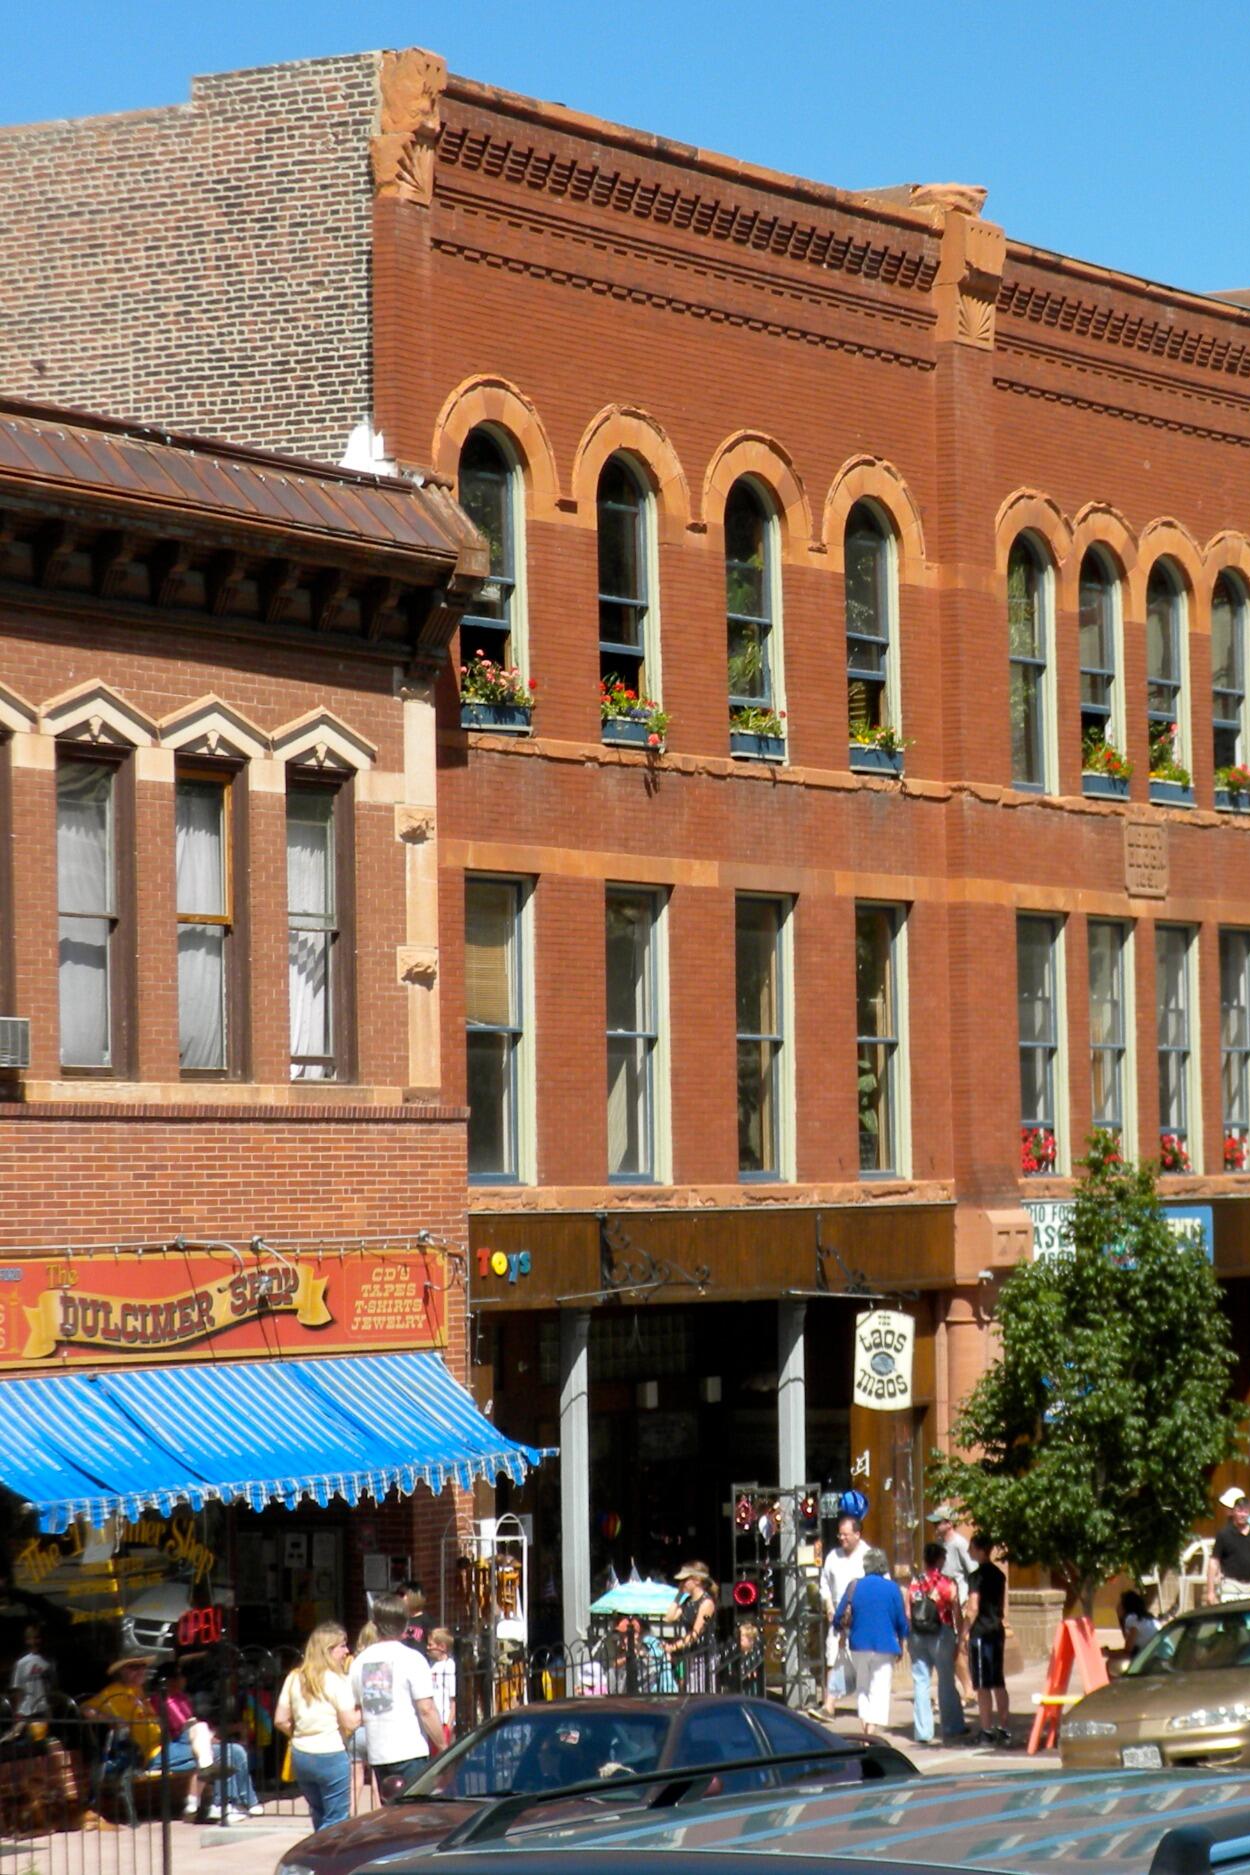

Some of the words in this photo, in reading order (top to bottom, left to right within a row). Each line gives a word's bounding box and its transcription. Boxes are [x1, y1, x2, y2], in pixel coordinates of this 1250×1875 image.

[47, 1265, 79, 1287] The
[361, 1282, 416, 1298] TAPES
[60, 1289, 215, 1344] DULCIMER
[230, 1267, 299, 1315] SHOP
[355, 1298, 423, 1314] T-SHIRTS
[351, 1314, 427, 1331] JEWELRY
[17, 1537, 62, 1584] The
[165, 1516, 214, 1584] Shop
